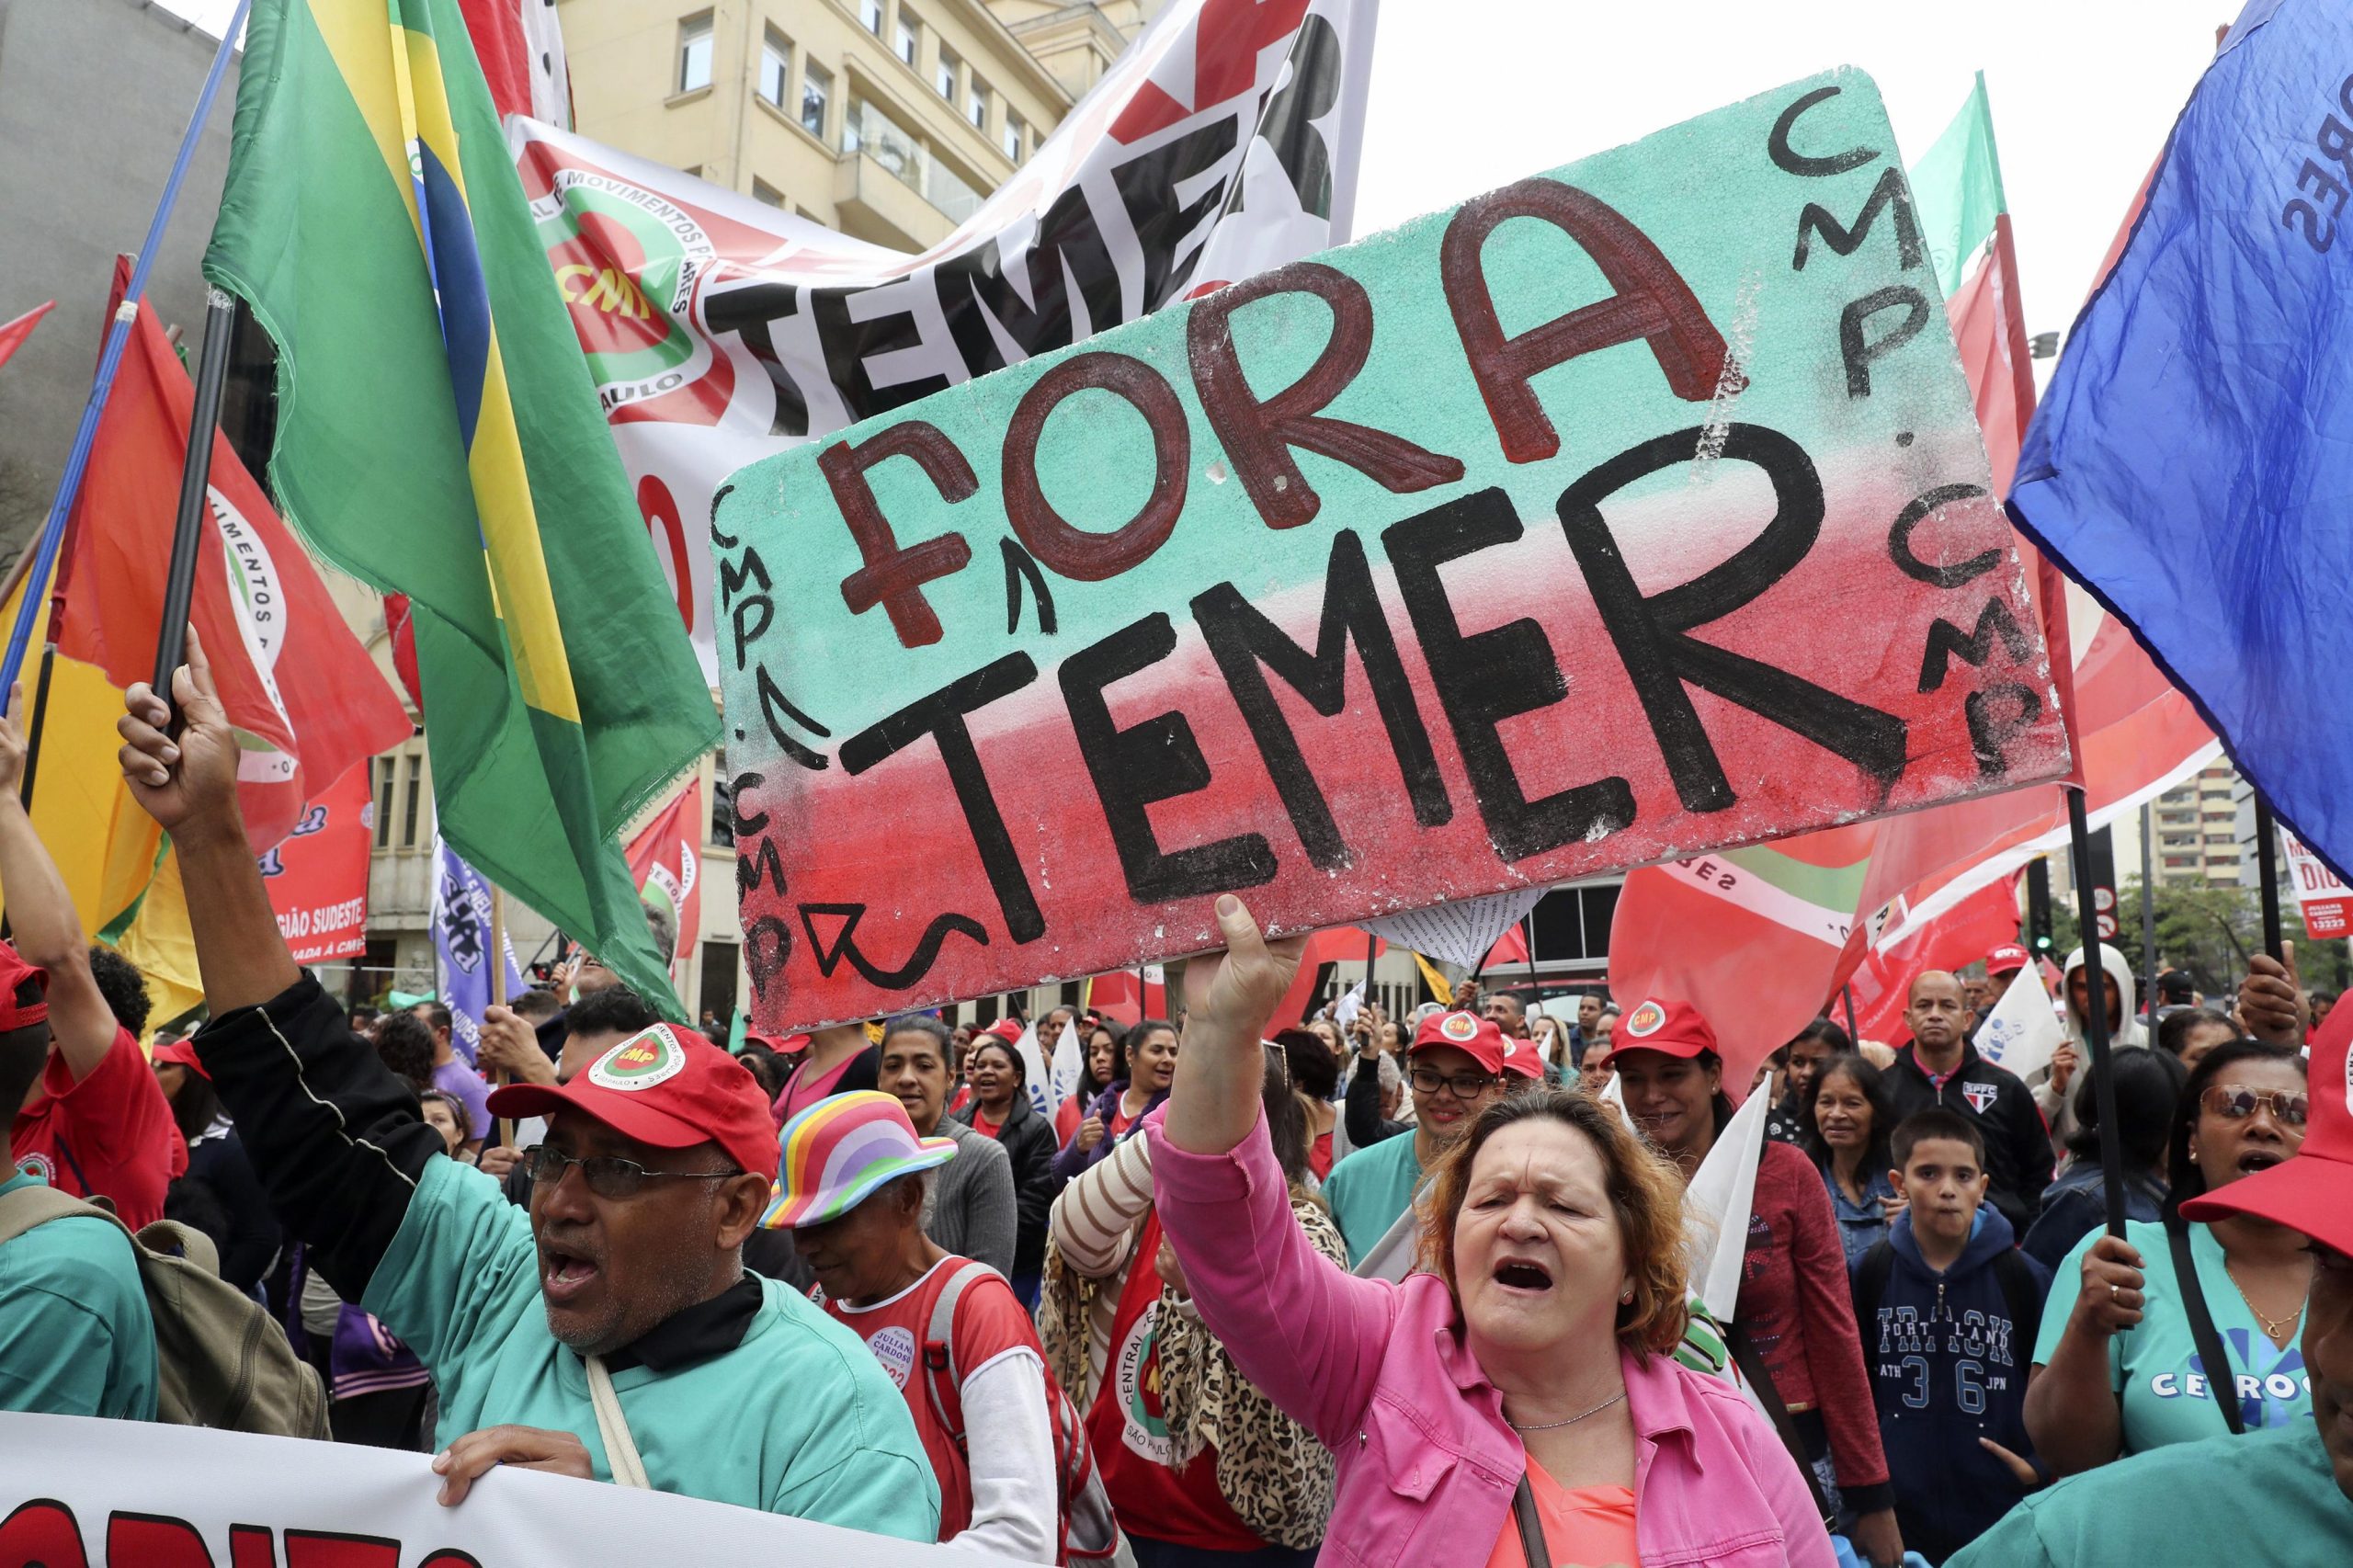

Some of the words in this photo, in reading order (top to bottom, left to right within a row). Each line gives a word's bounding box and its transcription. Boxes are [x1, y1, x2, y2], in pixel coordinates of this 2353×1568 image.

[566, 170, 703, 244] MOVIMENTOS
[818, 178, 1749, 649] FORA
[837, 422, 1908, 945] TEMER
[312, 896, 363, 935] SUDESTE
[1448, 1019, 1471, 1032] CMP
[1634, 1012, 1656, 1026] CMP
[1963, 1084, 1997, 1096] SPFC
[873, 1340, 912, 1364] CARDOSO
[1880, 1364, 1902, 1379] ATH
[1985, 1377, 2007, 1391] JPN
[1126, 1426, 1146, 1447] SÃO
